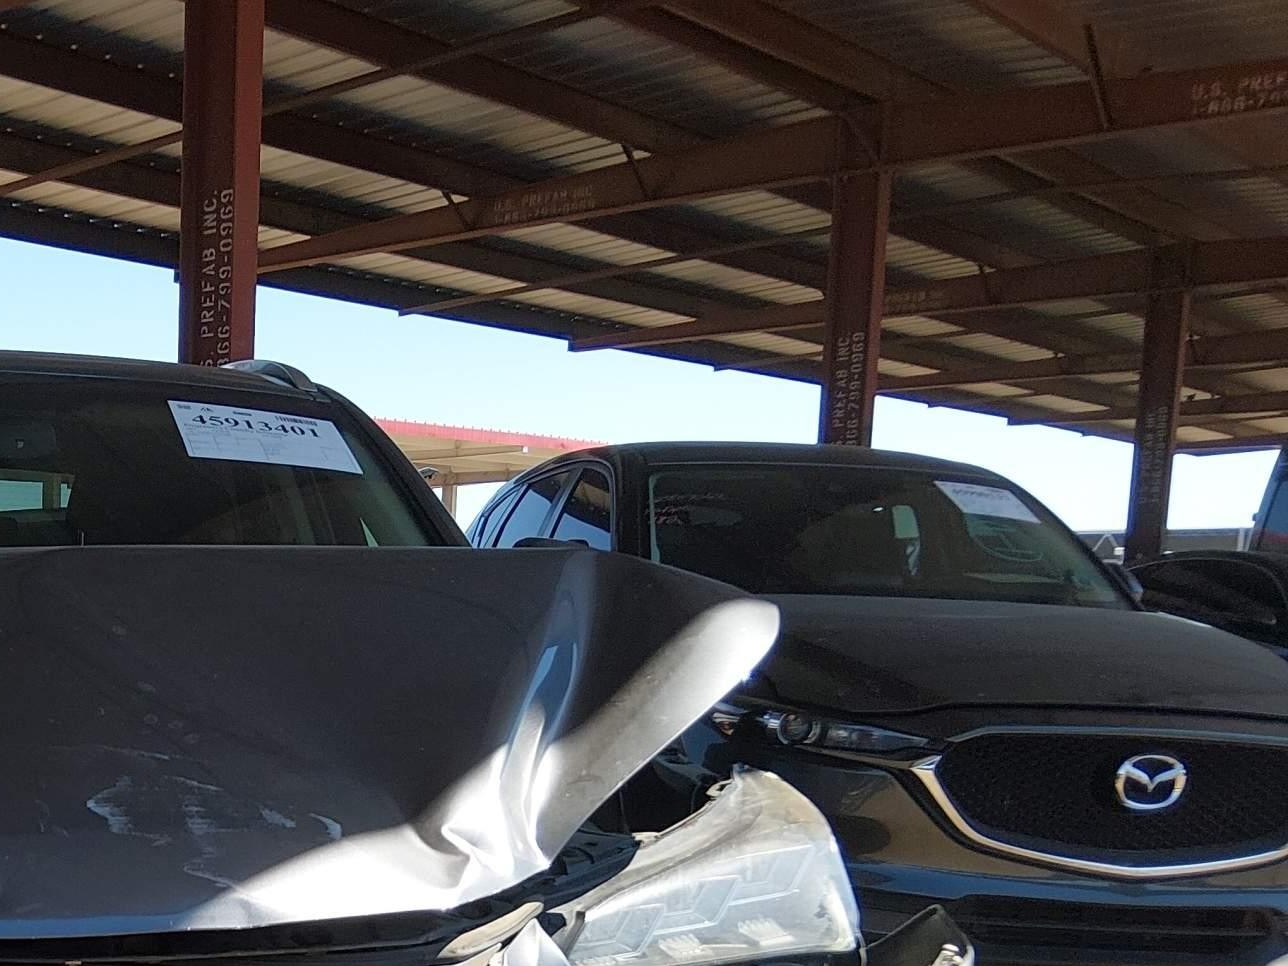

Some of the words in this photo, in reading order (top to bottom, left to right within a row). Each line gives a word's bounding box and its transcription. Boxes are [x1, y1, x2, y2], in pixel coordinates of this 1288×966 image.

[203, 189, 218, 235] INC.
[200, 248, 216, 338] PREFAB
[192, 414, 320, 438] 45913401
